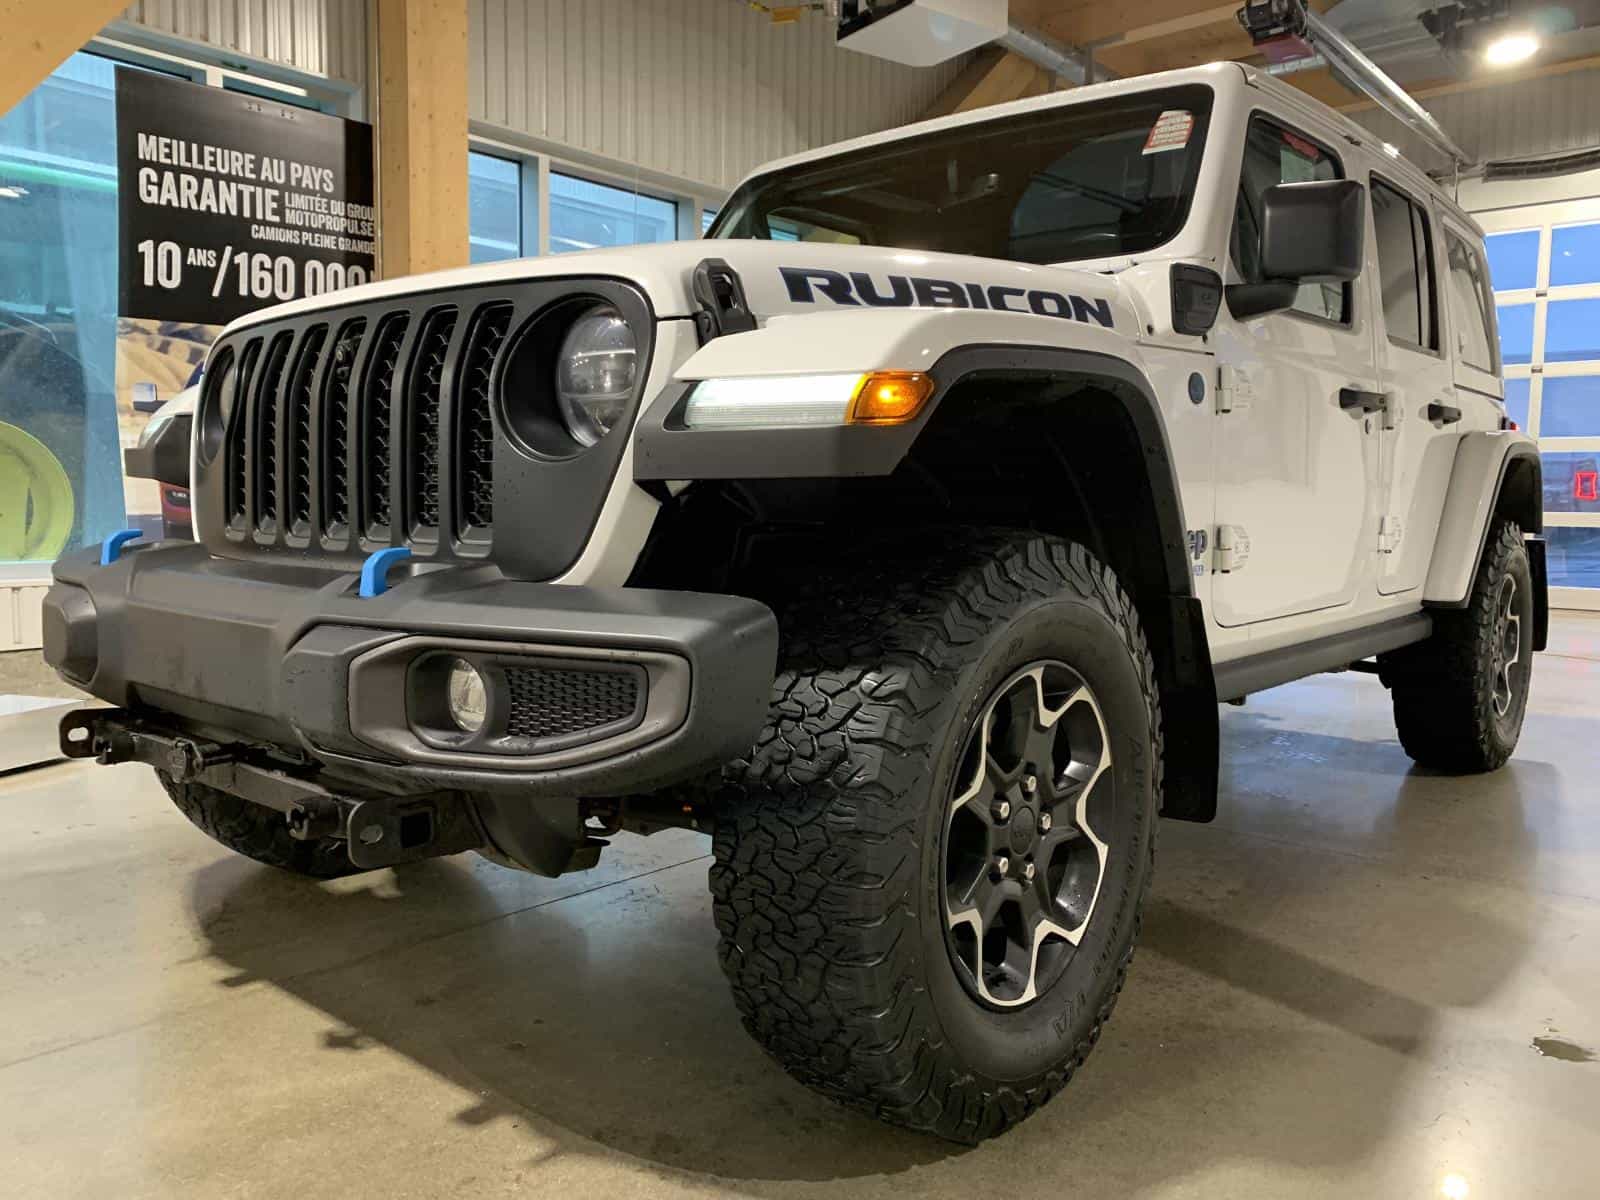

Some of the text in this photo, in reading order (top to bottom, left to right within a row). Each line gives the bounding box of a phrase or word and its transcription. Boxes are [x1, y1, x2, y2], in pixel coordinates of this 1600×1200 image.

[138, 132, 334, 193] MEILLEURE AU PAYS
[139, 167, 280, 223] GARANTIE
[284, 191, 328, 214] LIMITÉE
[330, 200, 345, 217] DU
[251, 224, 300, 245] CAMIONS
[302, 231, 337, 250] PLEINE
[138, 240, 181, 289] 10
[187, 248, 216, 268] ANS
[779, 266, 1114, 328] RUBICON
